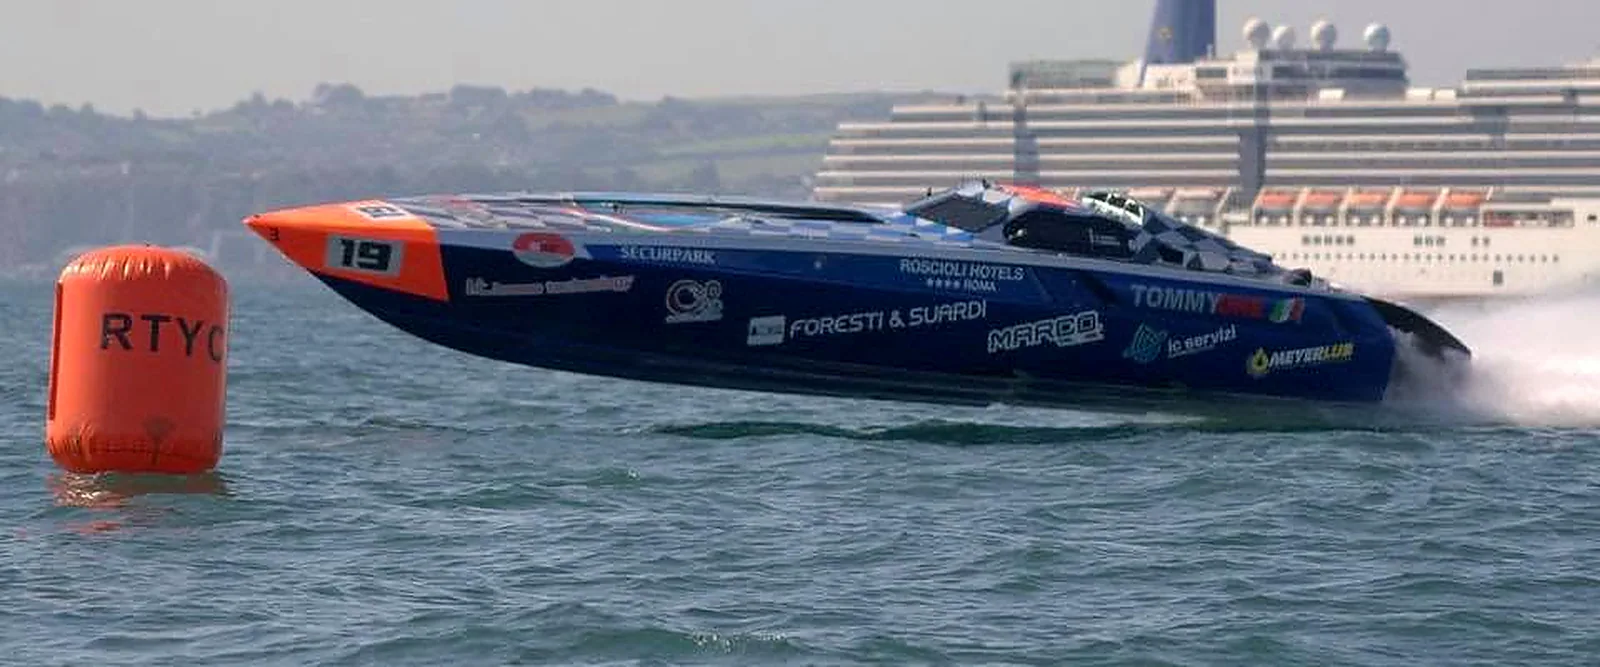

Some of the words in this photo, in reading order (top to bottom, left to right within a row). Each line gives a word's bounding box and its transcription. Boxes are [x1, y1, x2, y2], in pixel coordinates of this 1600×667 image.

[340, 239, 392, 271] 19
[620, 245, 715, 264] SECURPARK
[900, 257, 967, 278] ROSCIOLI
[969, 264, 1024, 281] HOTELS
[963, 279, 997, 292] ROMA
[790, 312, 884, 338] FORESTI
[889, 309, 905, 328] &
[909, 300, 987, 327] SUARDI
[101, 313, 225, 363] RTYC
